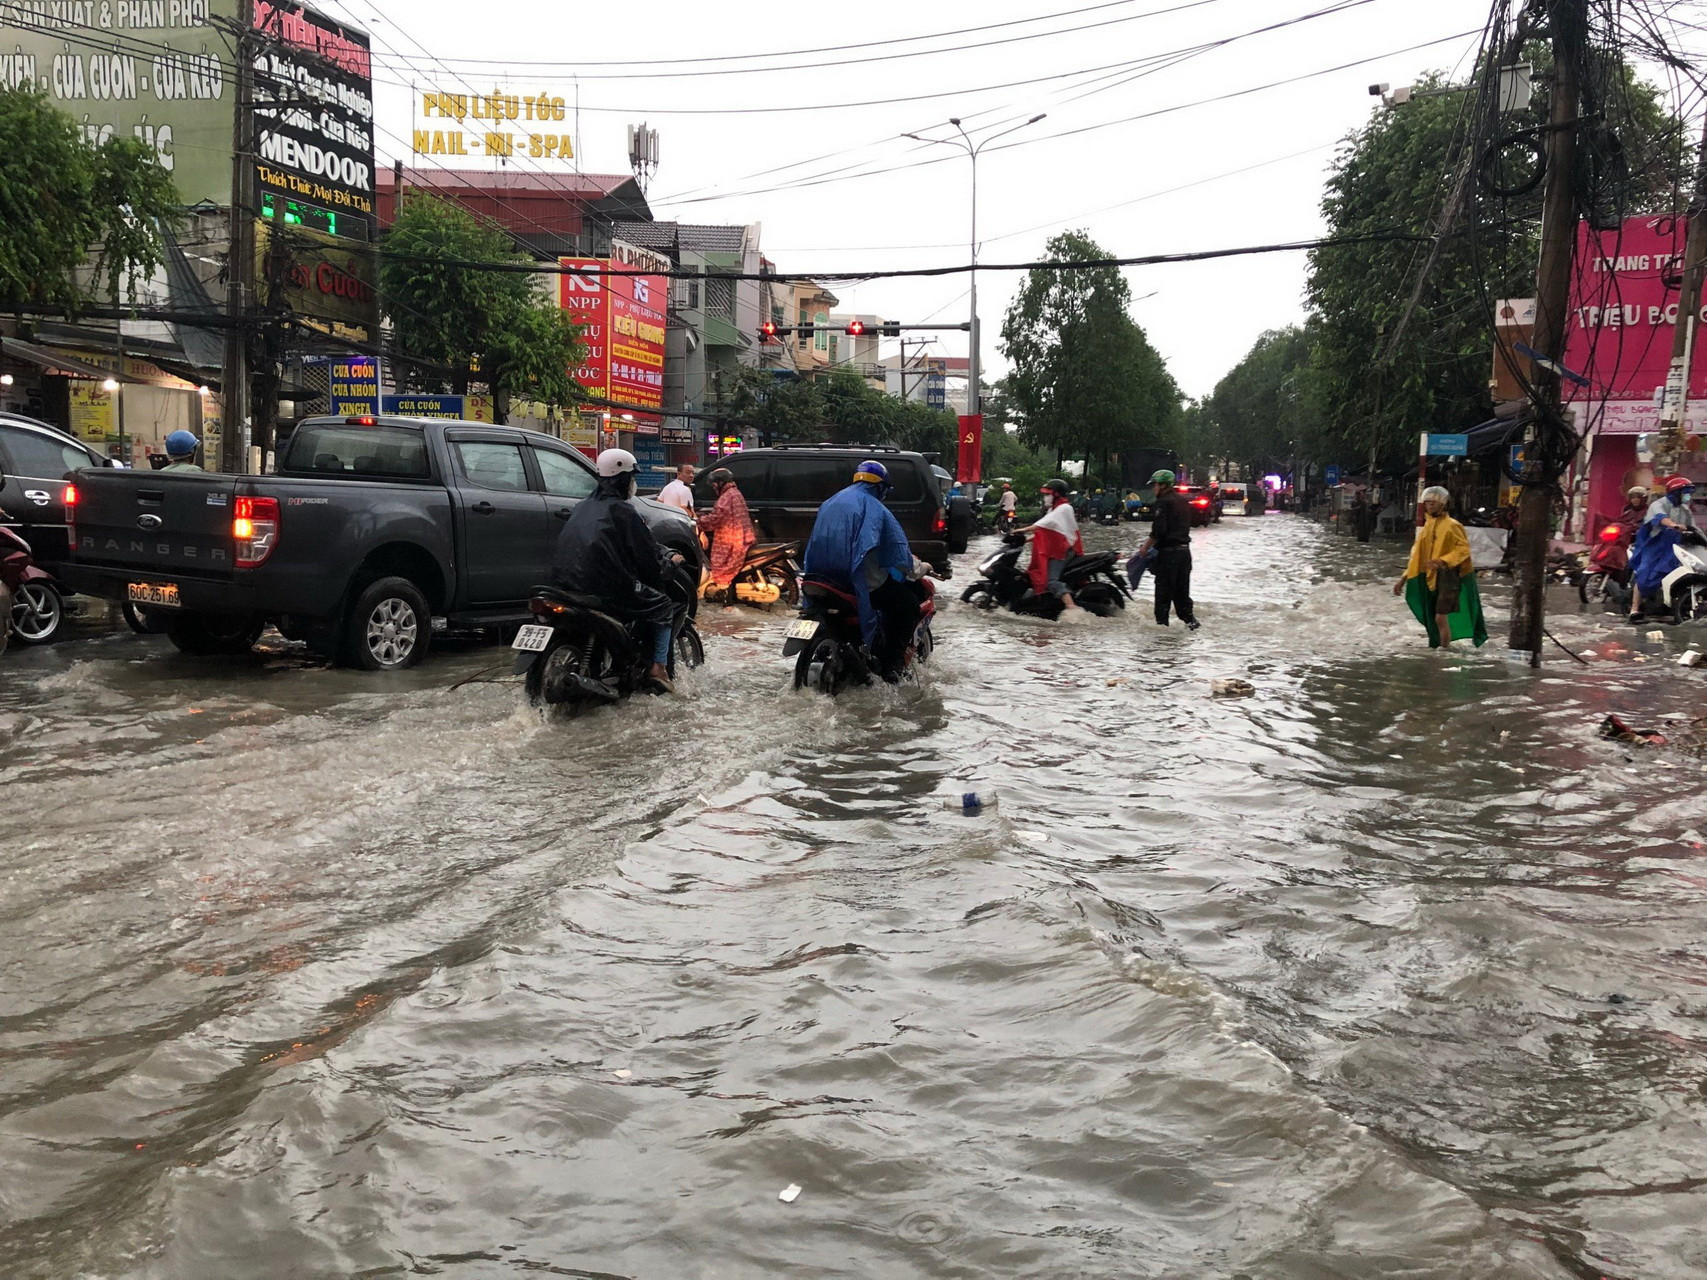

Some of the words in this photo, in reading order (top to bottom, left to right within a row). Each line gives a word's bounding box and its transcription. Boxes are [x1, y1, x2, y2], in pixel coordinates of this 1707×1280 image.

[100, 1, 112, 28] &
[423, 92, 469, 125] PHỤ
[471, 88, 521, 126] LIỆU
[523, 91, 566, 121] TÓC
[413, 129, 468, 155] NAIL
[485, 132, 513, 156] MI
[529, 133, 574, 158] SPA
[260, 129, 370, 191] MENDOOR
[568, 296, 601, 309] NPP
[1574, 302, 1642, 332] TRIỆU
[338, 402, 371, 416] XINGFA
[82, 536, 226, 561] RANGER
